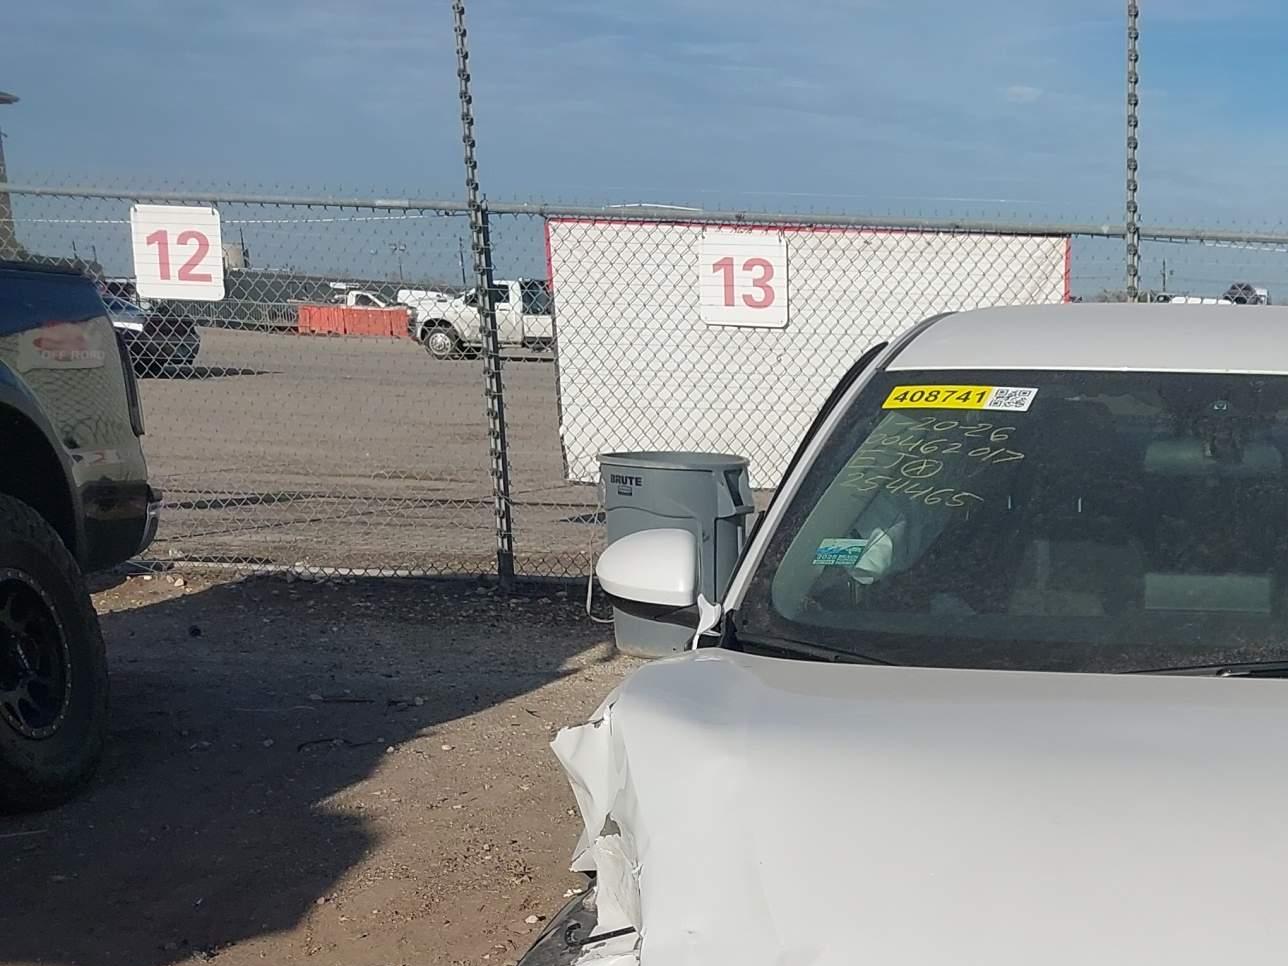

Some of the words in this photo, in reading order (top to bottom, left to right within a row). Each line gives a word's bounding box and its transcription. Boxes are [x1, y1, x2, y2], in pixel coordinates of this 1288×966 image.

[146, 229, 213, 283] 12
[712, 256, 776, 309] 13
[893, 389, 987, 404] 408741
[609, 473, 643, 487] BRUTE
